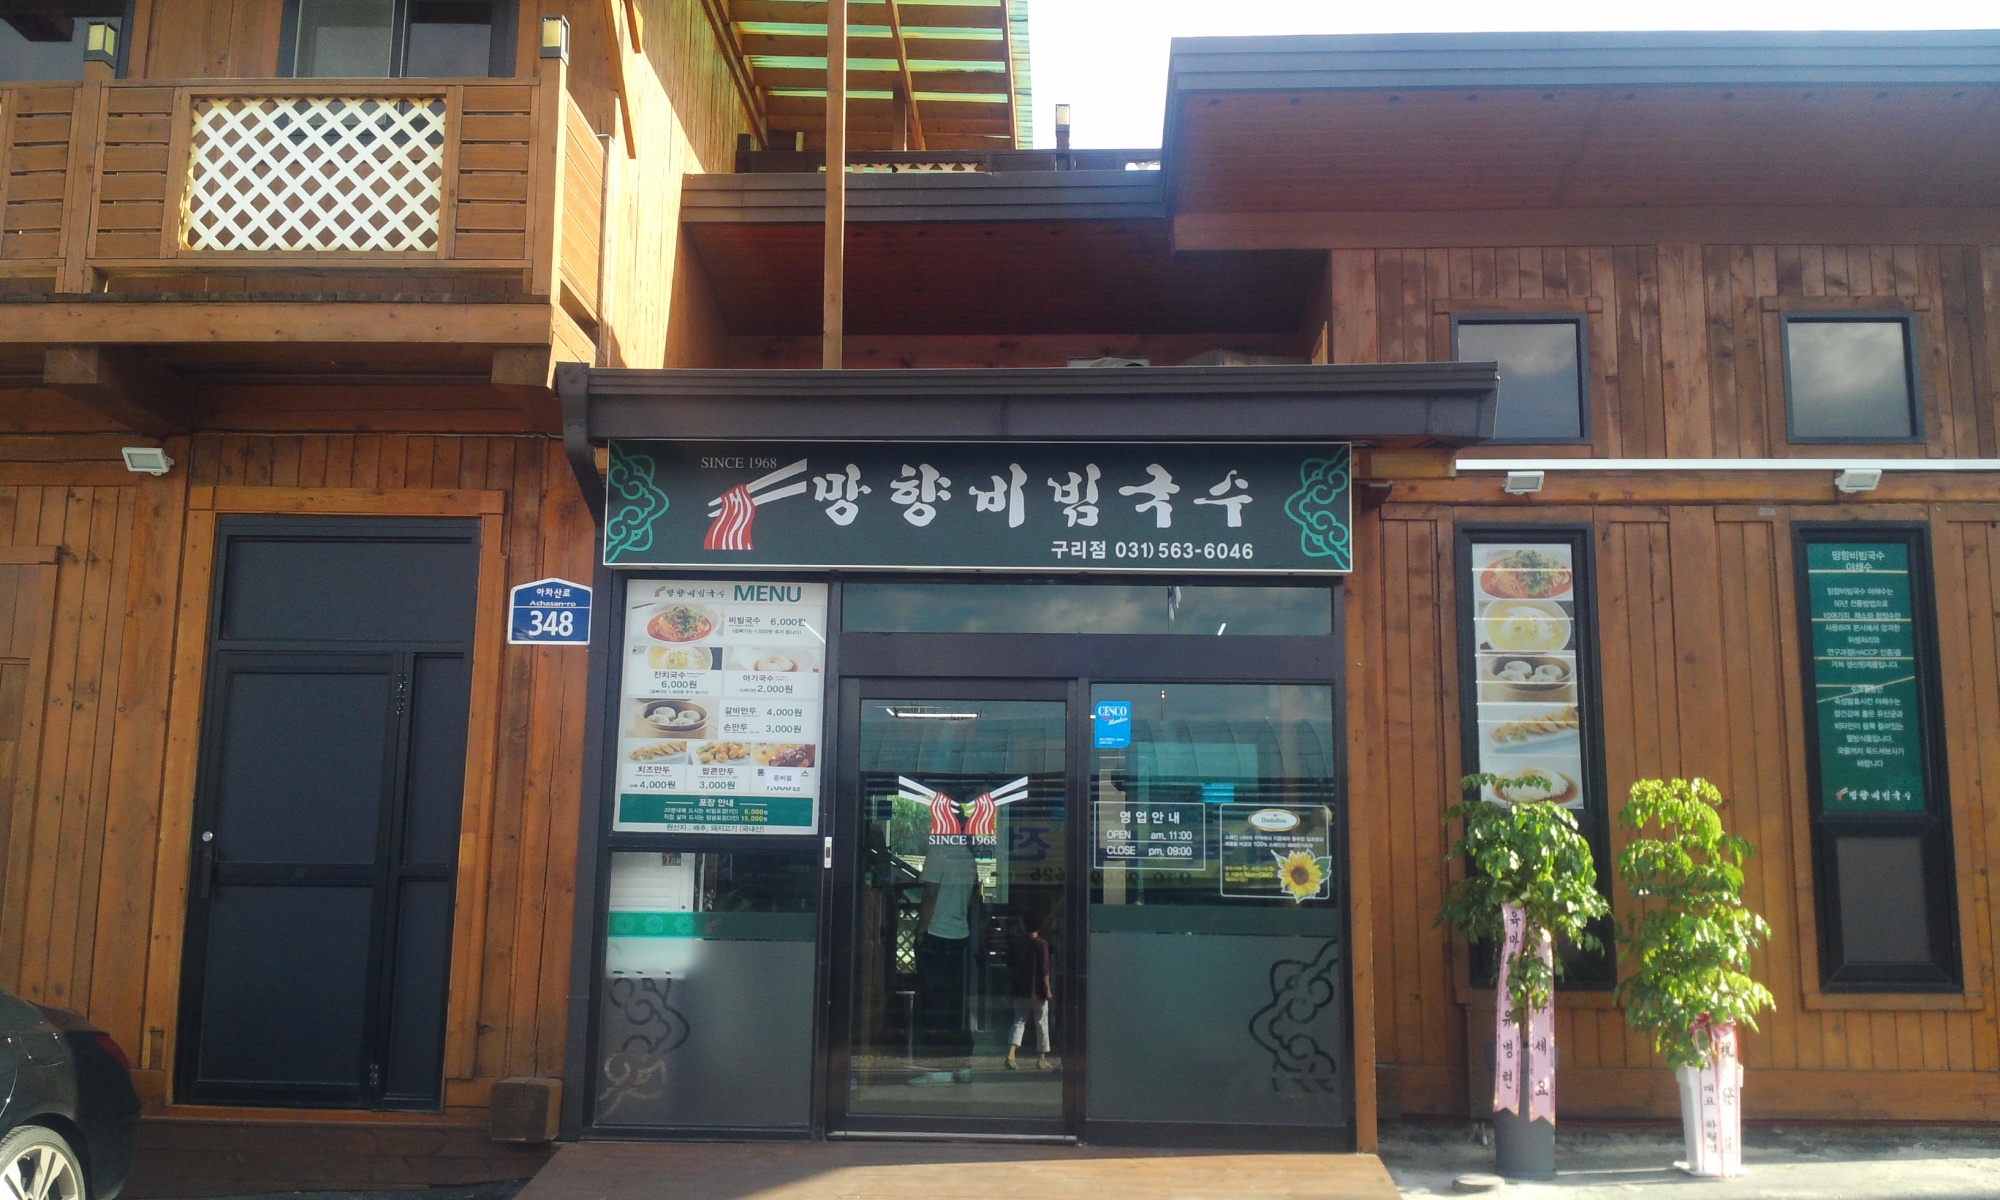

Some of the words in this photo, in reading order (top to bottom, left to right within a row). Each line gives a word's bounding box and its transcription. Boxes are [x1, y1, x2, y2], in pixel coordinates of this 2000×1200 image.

[701, 457, 743, 469] SINCE
[749, 457, 777, 469] 1968
[812, 463, 1253, 528] 망향비빔국수
[1051, 540, 1106, 559] 구리점
[1115, 541, 1254, 559] 031)563-6046
[536, 587, 571, 599] 아차산로
[733, 584, 802, 602] MENU
[528, 610, 574, 637] 348
[728, 616, 761, 625] 비빔국수
[653, 671, 686, 680] 잔치국수
[742, 674, 774, 682] 아기국수
[661, 680, 697, 689] 6,000원
[757, 684, 793, 693] 2,000원
[724, 706, 758, 715] 갈비만두
[766, 708, 803, 717] 4,000원
[1097, 705, 1128, 717] CESCO
[723, 723, 748, 732] 손만두
[765, 724, 802, 733] 3,000원
[637, 765, 671, 774] 치즈만두
[701, 766, 735, 775] 팝콘만두
[639, 780, 676, 789] 4,000원
[699, 780, 736, 790] 3,000원
[698, 798, 715, 807] 포장
[717, 799, 734, 808] 안내
[1119, 811, 1180, 824] 영업안내
[929, 835, 967, 846] SINCE
[971, 834, 997, 846] 1968
[1106, 830, 1131, 839] OPEN
[1169, 831, 1193, 841] 11:00
[1106, 846, 1136, 855] CLOSE
[1167, 846, 1193, 856] 09:00
